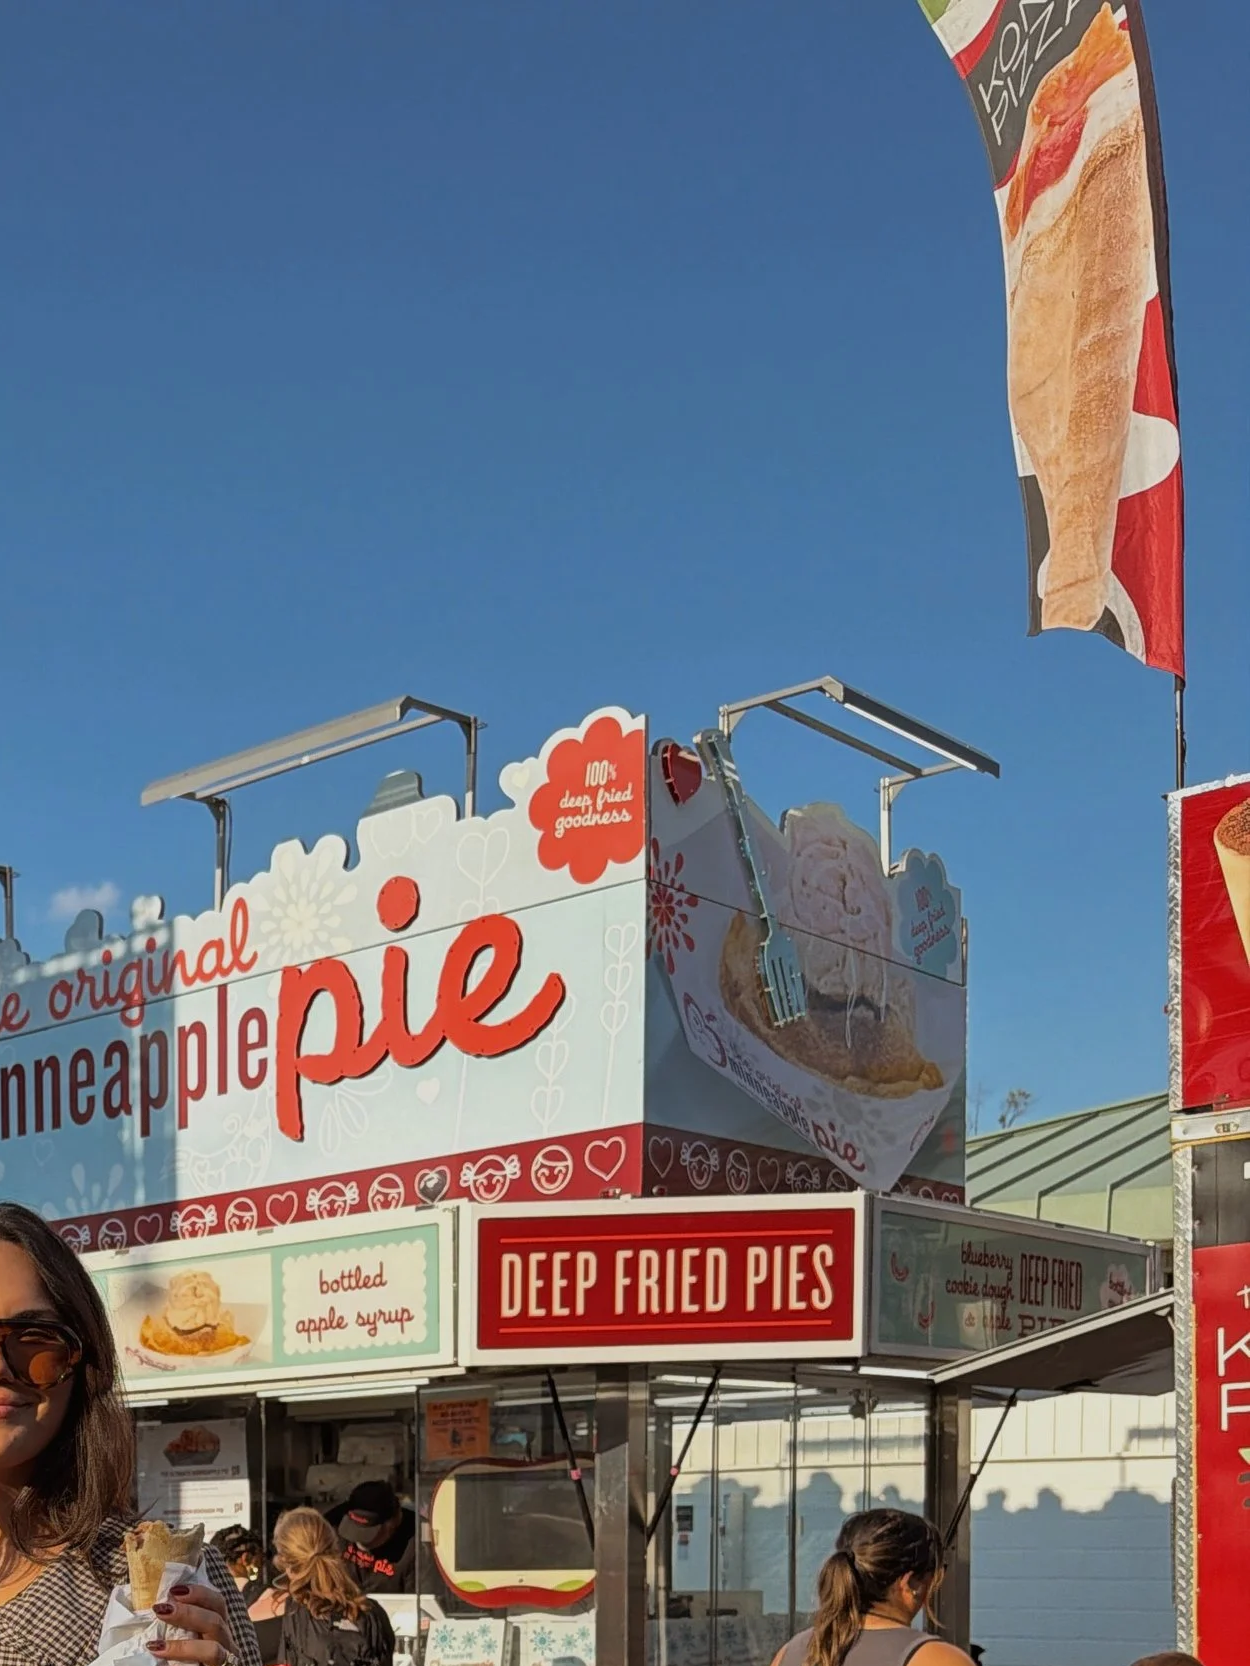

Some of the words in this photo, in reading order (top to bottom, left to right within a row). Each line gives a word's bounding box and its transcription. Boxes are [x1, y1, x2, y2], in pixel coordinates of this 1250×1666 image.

[585, 759, 617, 787] 100%
[559, 790, 593, 813] deep
[596, 782, 633, 811] fried
[555, 808, 632, 838] goodness
[49, 896, 258, 1028] original
[276, 875, 566, 1143] pie
[728, 1055, 812, 1135] minneapple
[811, 1119, 866, 1172] pie
[319, 1261, 388, 1295] bottled
[500, 1250, 598, 1319] DEEP
[614, 1246, 727, 1315] FRIED
[745, 1242, 834, 1311] PIES
[961, 1240, 1014, 1281] blueberry
[946, 1270, 980, 1296] cookie
[981, 1271, 1015, 1308] dough
[1020, 1253, 1049, 1307] DEEP
[1051, 1257, 1084, 1312] FRIED
[296, 1306, 349, 1344] apple
[355, 1306, 415, 1338] syrup
